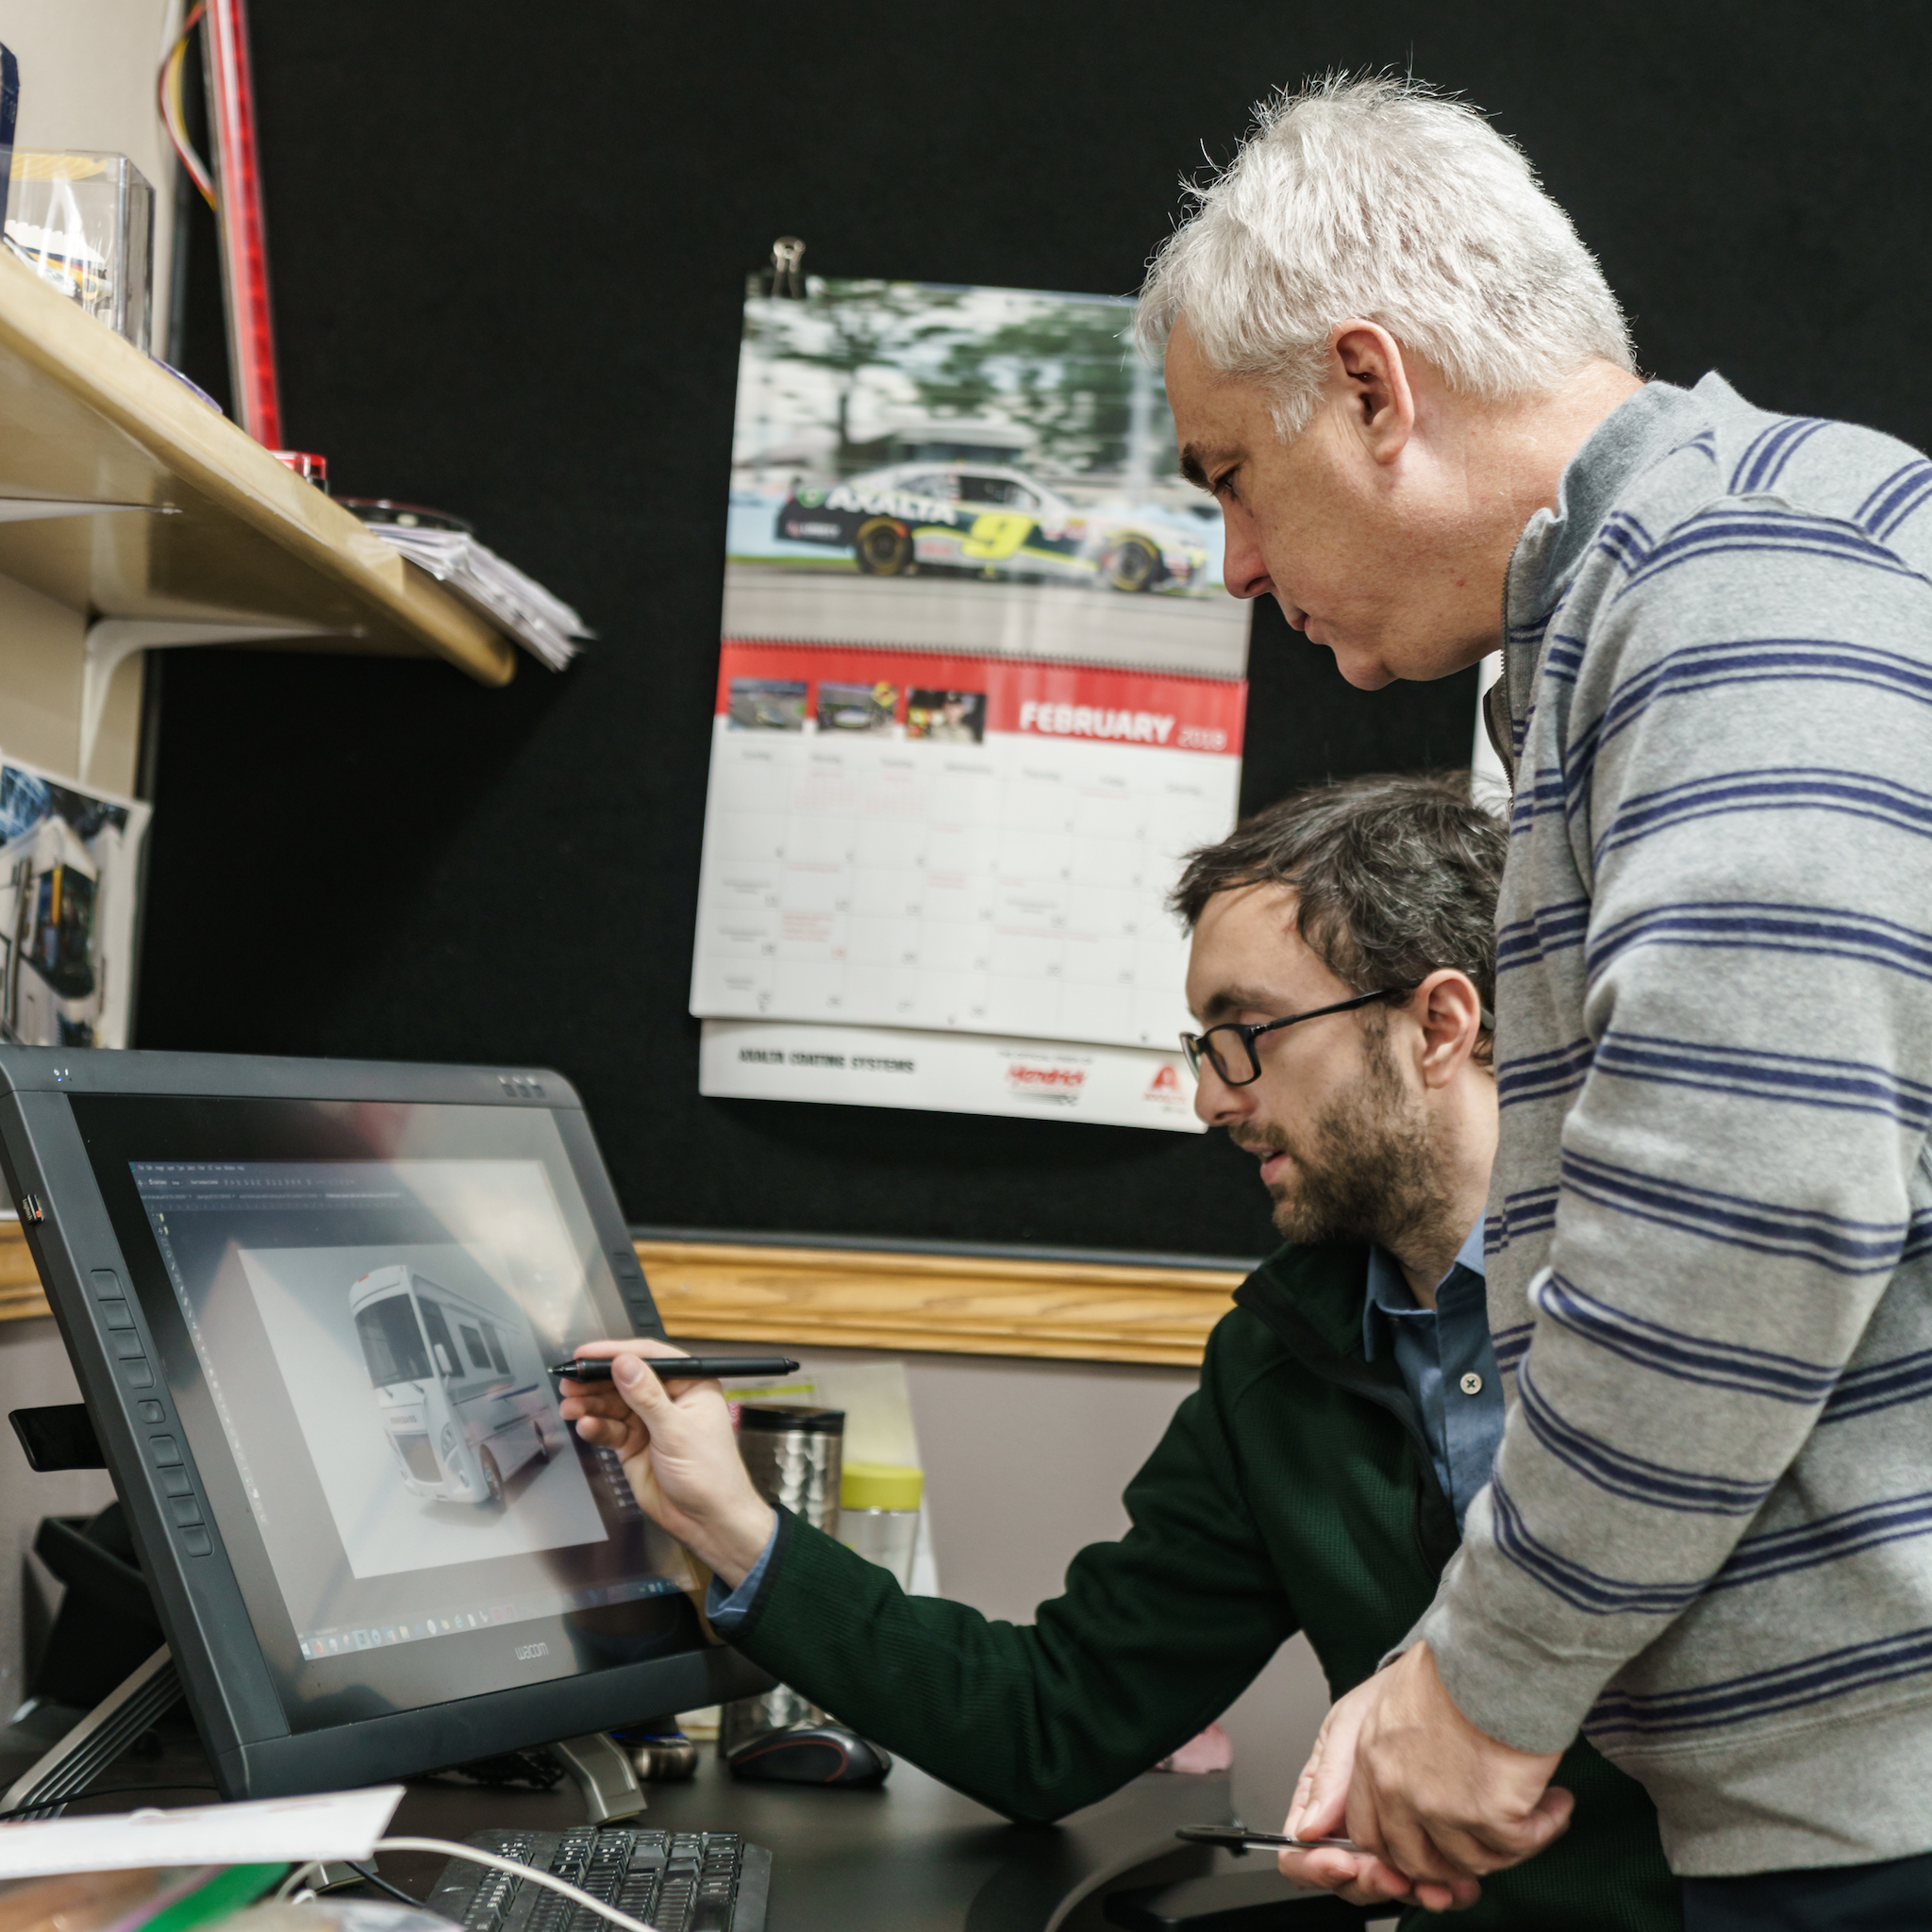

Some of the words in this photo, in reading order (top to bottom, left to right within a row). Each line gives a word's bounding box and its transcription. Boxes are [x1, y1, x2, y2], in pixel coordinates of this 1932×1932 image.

[824, 485, 957, 525] AXALTA
[961, 512, 1034, 559] 9
[1019, 701, 1175, 744] FEBRUARY
[1178, 726, 1226, 751] 2018
[851, 1056, 914, 1074] SYSTEMS
